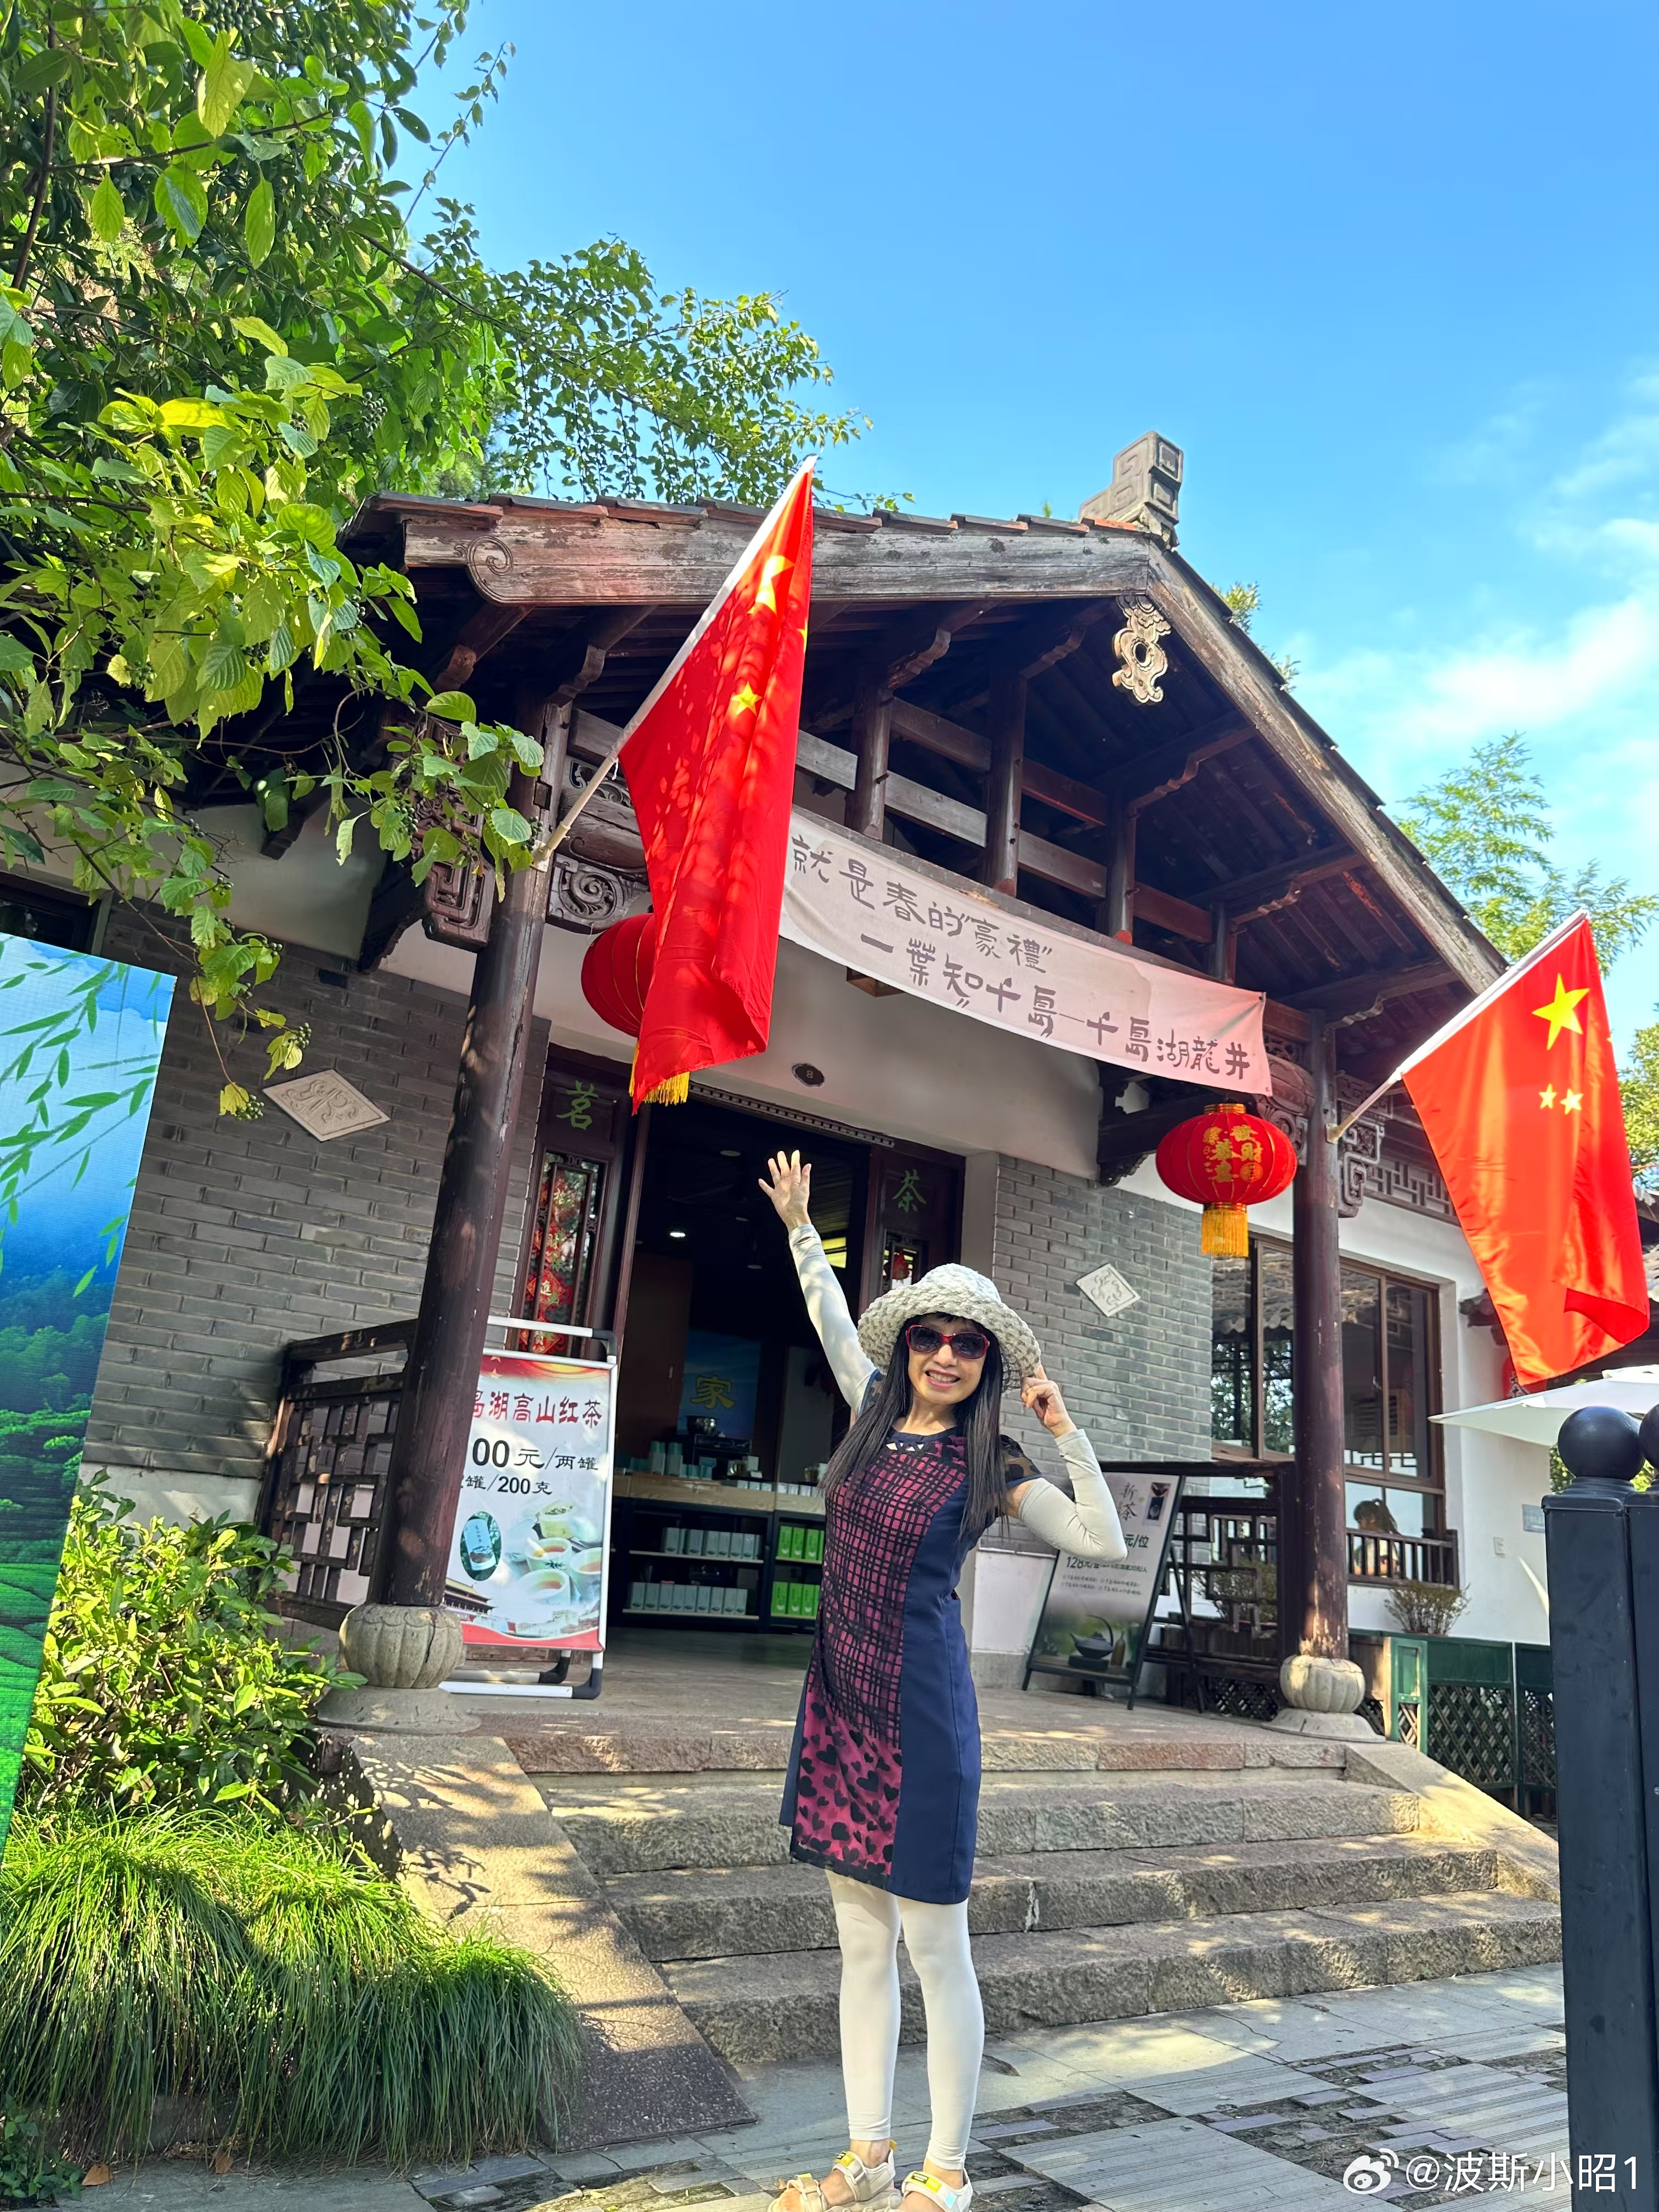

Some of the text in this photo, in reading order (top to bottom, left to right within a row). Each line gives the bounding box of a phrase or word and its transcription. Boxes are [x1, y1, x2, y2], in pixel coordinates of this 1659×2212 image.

[556, 1080, 600, 1130] 茗
[891, 1169, 927, 1213] 茶
[690, 1374, 736, 1410] 家
[460, 1472, 553, 1496] 罐/200克
